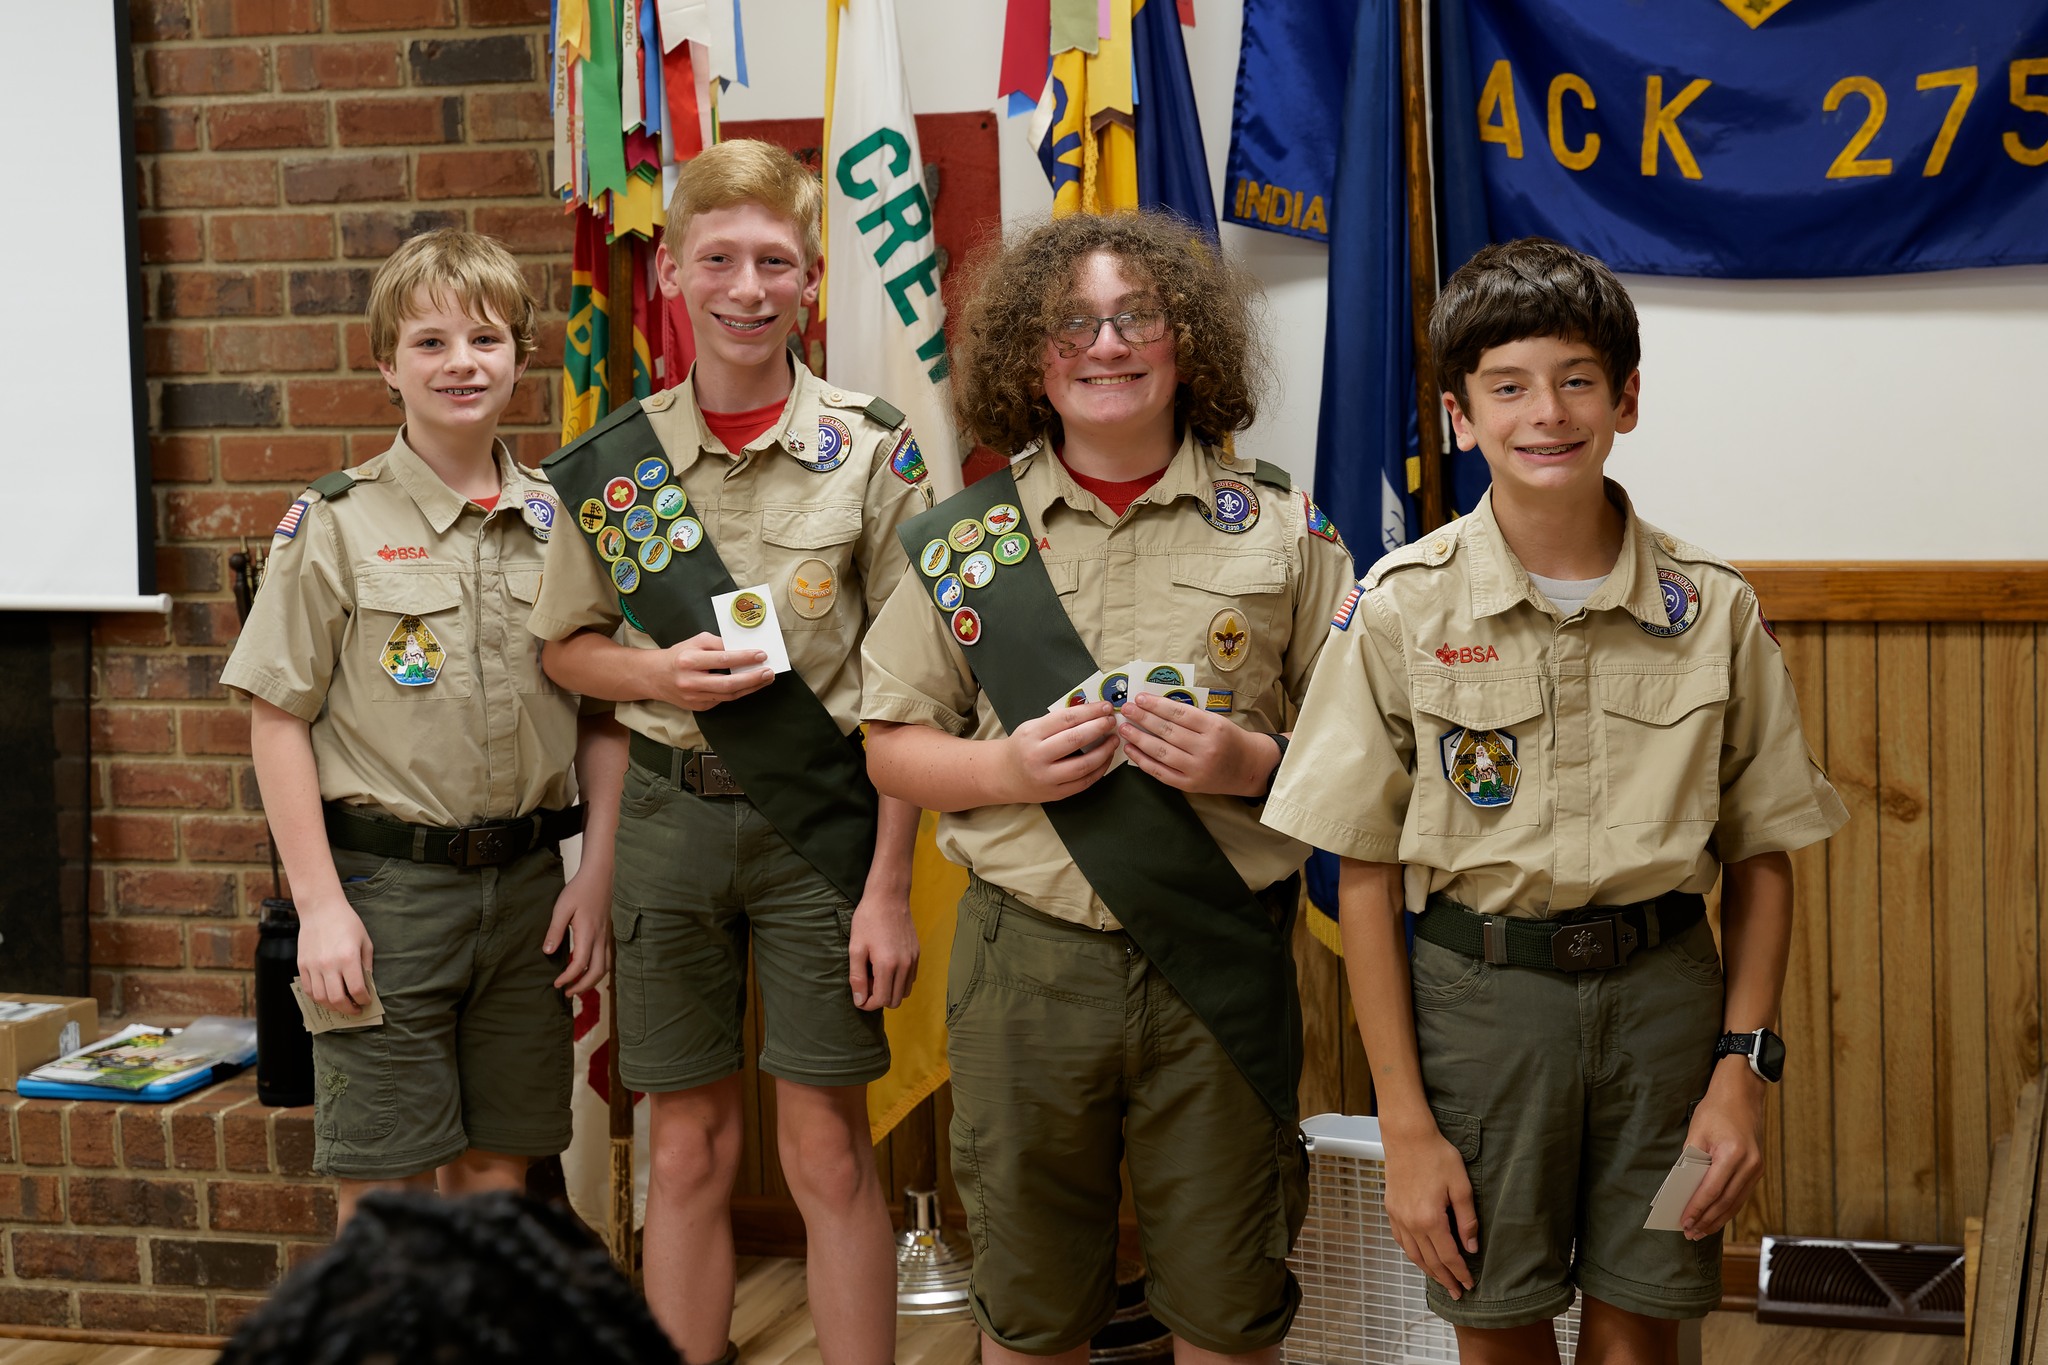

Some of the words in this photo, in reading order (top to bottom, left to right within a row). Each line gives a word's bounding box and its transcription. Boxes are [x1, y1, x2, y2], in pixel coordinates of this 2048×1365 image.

[557, 55, 566, 109] PATROL
[1477, 59, 1713, 179] ACK
[1820, 57, 2048, 179] 275
[1234, 177, 1328, 234] INDIA
[397, 546, 430, 560] BSA
[1668, 573, 1695, 598] AMERICA
[1646, 623, 1669, 635] SINCE
[1670, 623, 1684, 634] 1910
[1459, 645, 1500, 663] BSA
